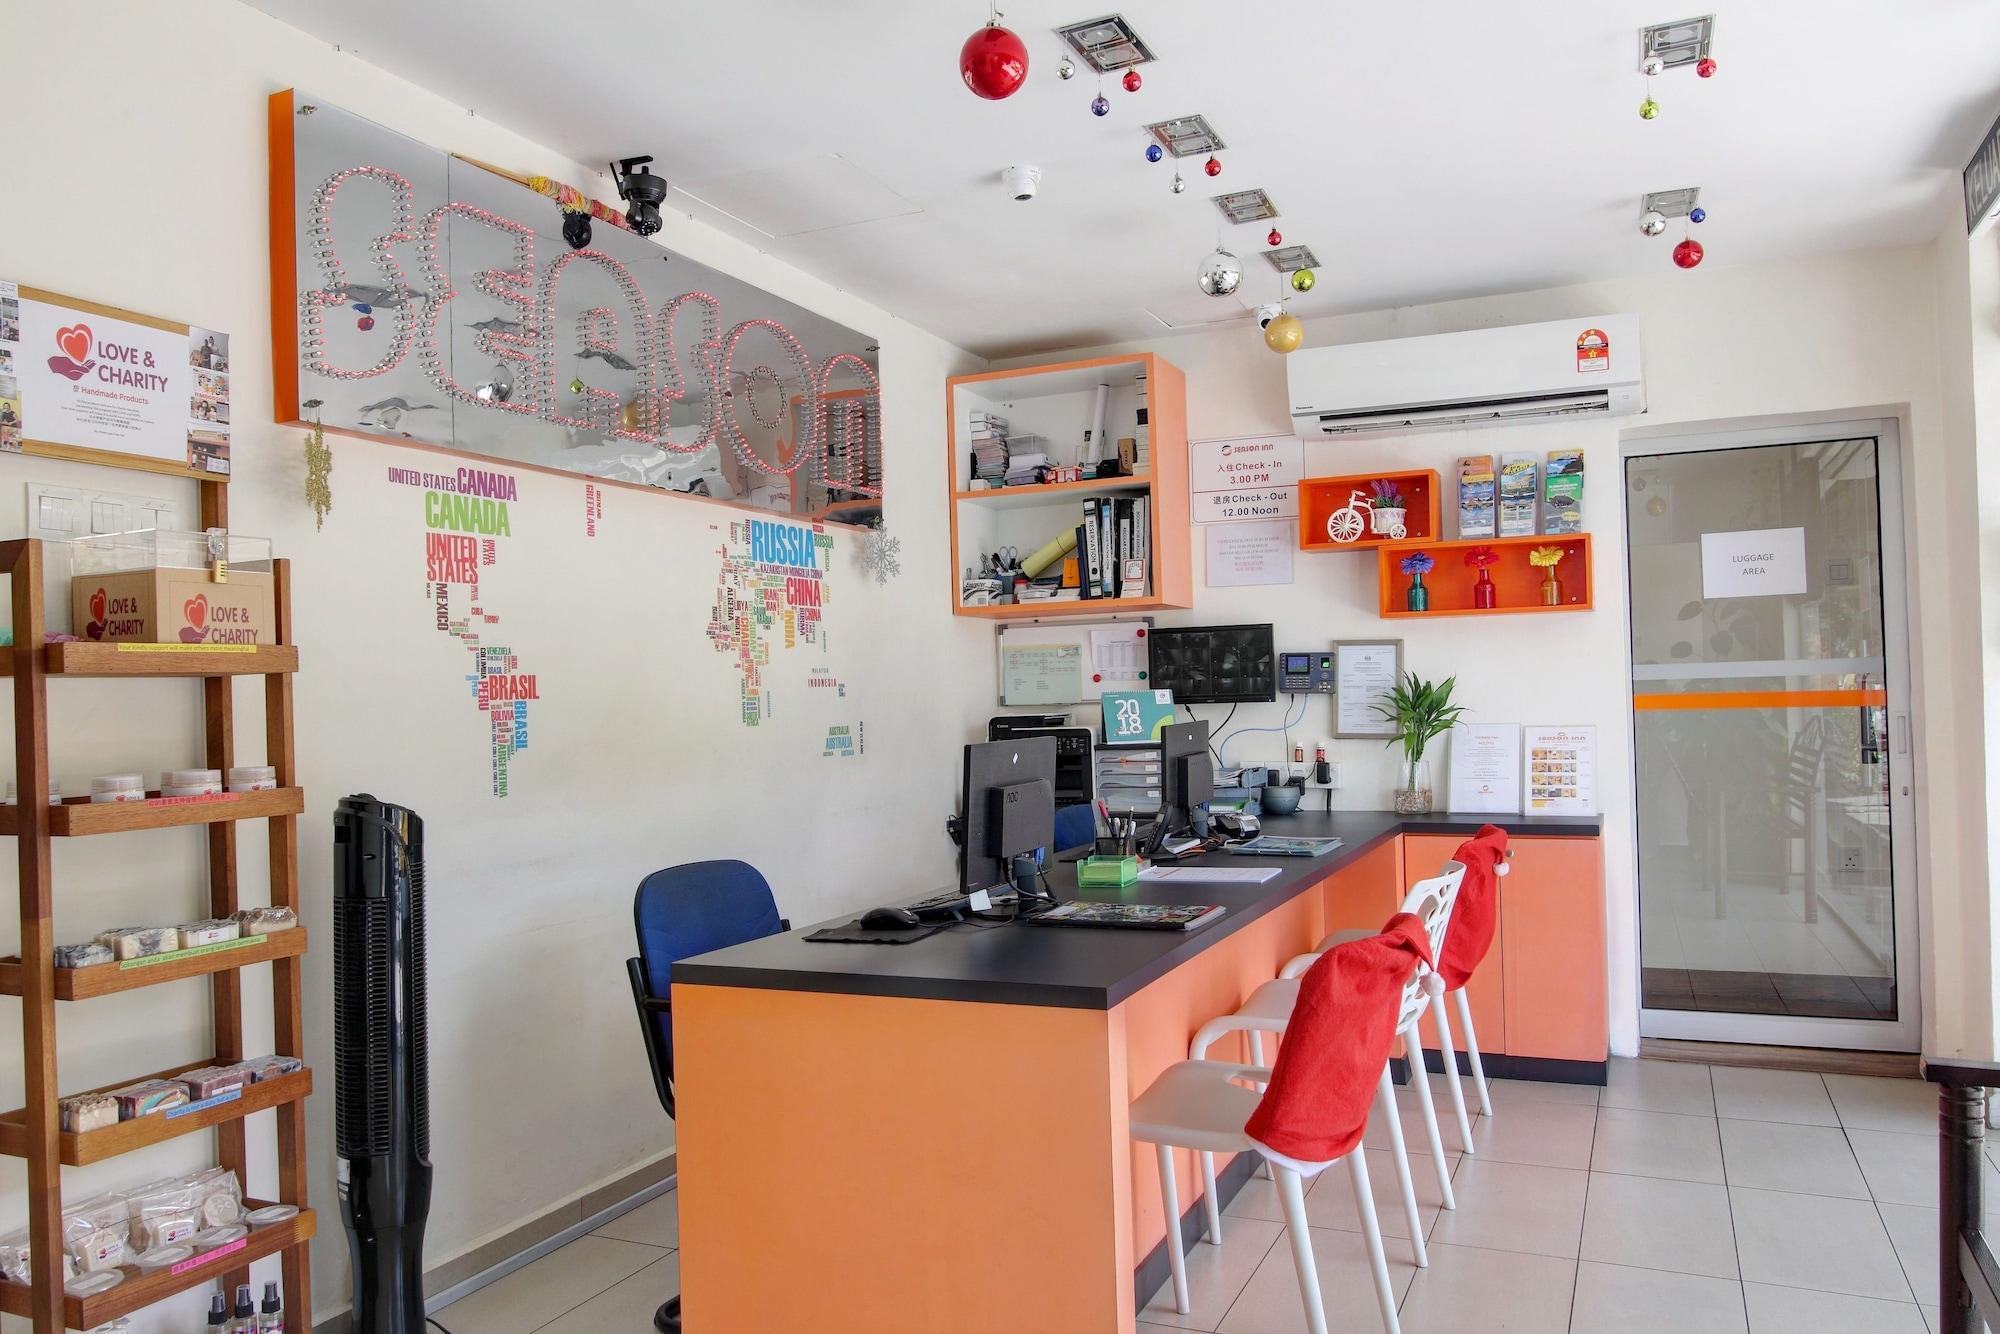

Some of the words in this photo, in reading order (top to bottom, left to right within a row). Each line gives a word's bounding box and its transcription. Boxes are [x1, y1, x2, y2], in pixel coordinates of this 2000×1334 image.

[98, 341, 138, 365] LOVE
[143, 351, 155, 368] &
[98, 365, 168, 392] CHARITY
[81, 387, 117, 399] Handmade
[119, 392, 149, 404] Products
[388, 467, 421, 487] UNITED
[423, 473, 456, 492] STATES
[457, 467, 518, 502] CANADA
[1230, 475, 1251, 484] 3.00
[1254, 474, 1269, 482] PM
[425, 490, 511, 537] CANADA
[586, 484, 595, 537] GREENLAND
[1222, 508, 1249, 517] 12.00
[1252, 506, 1279, 515] Noon
[426, 532, 478, 561] UNITED
[751, 519, 816, 568] RUSSIA
[1732, 553, 1775, 563] LUGGAGE
[426, 557, 479, 584] STATES
[1742, 567, 1765, 575] AREA
[786, 577, 821, 607] CHINA
[108, 598, 129, 614] LOVE
[130, 597, 137, 613] &
[211, 606, 238, 623] LOVE
[240, 607, 249, 623] &
[436, 583, 449, 631] MEXICO
[804, 608, 821, 622] CHINA
[109, 618, 145, 636] CHARITY
[212, 627, 258, 644] CHARITY
[741, 617, 749, 646] CHAD
[784, 610, 795, 649] INDIA
[486, 647, 512, 656] VENEZUELA
[488, 674, 540, 701] BRASIL
[808, 678, 837, 688] INDONESIA
[478, 681, 489, 711] PERU
[1115, 699, 1140, 716] 20
[491, 711, 514, 722] BOLIVIA
[514, 701, 529, 752] BRASIL
[1117, 714, 1143, 735] 18
[826, 736, 853, 750] AUSTRALIA
[497, 744, 508, 798] ARGENTINA
